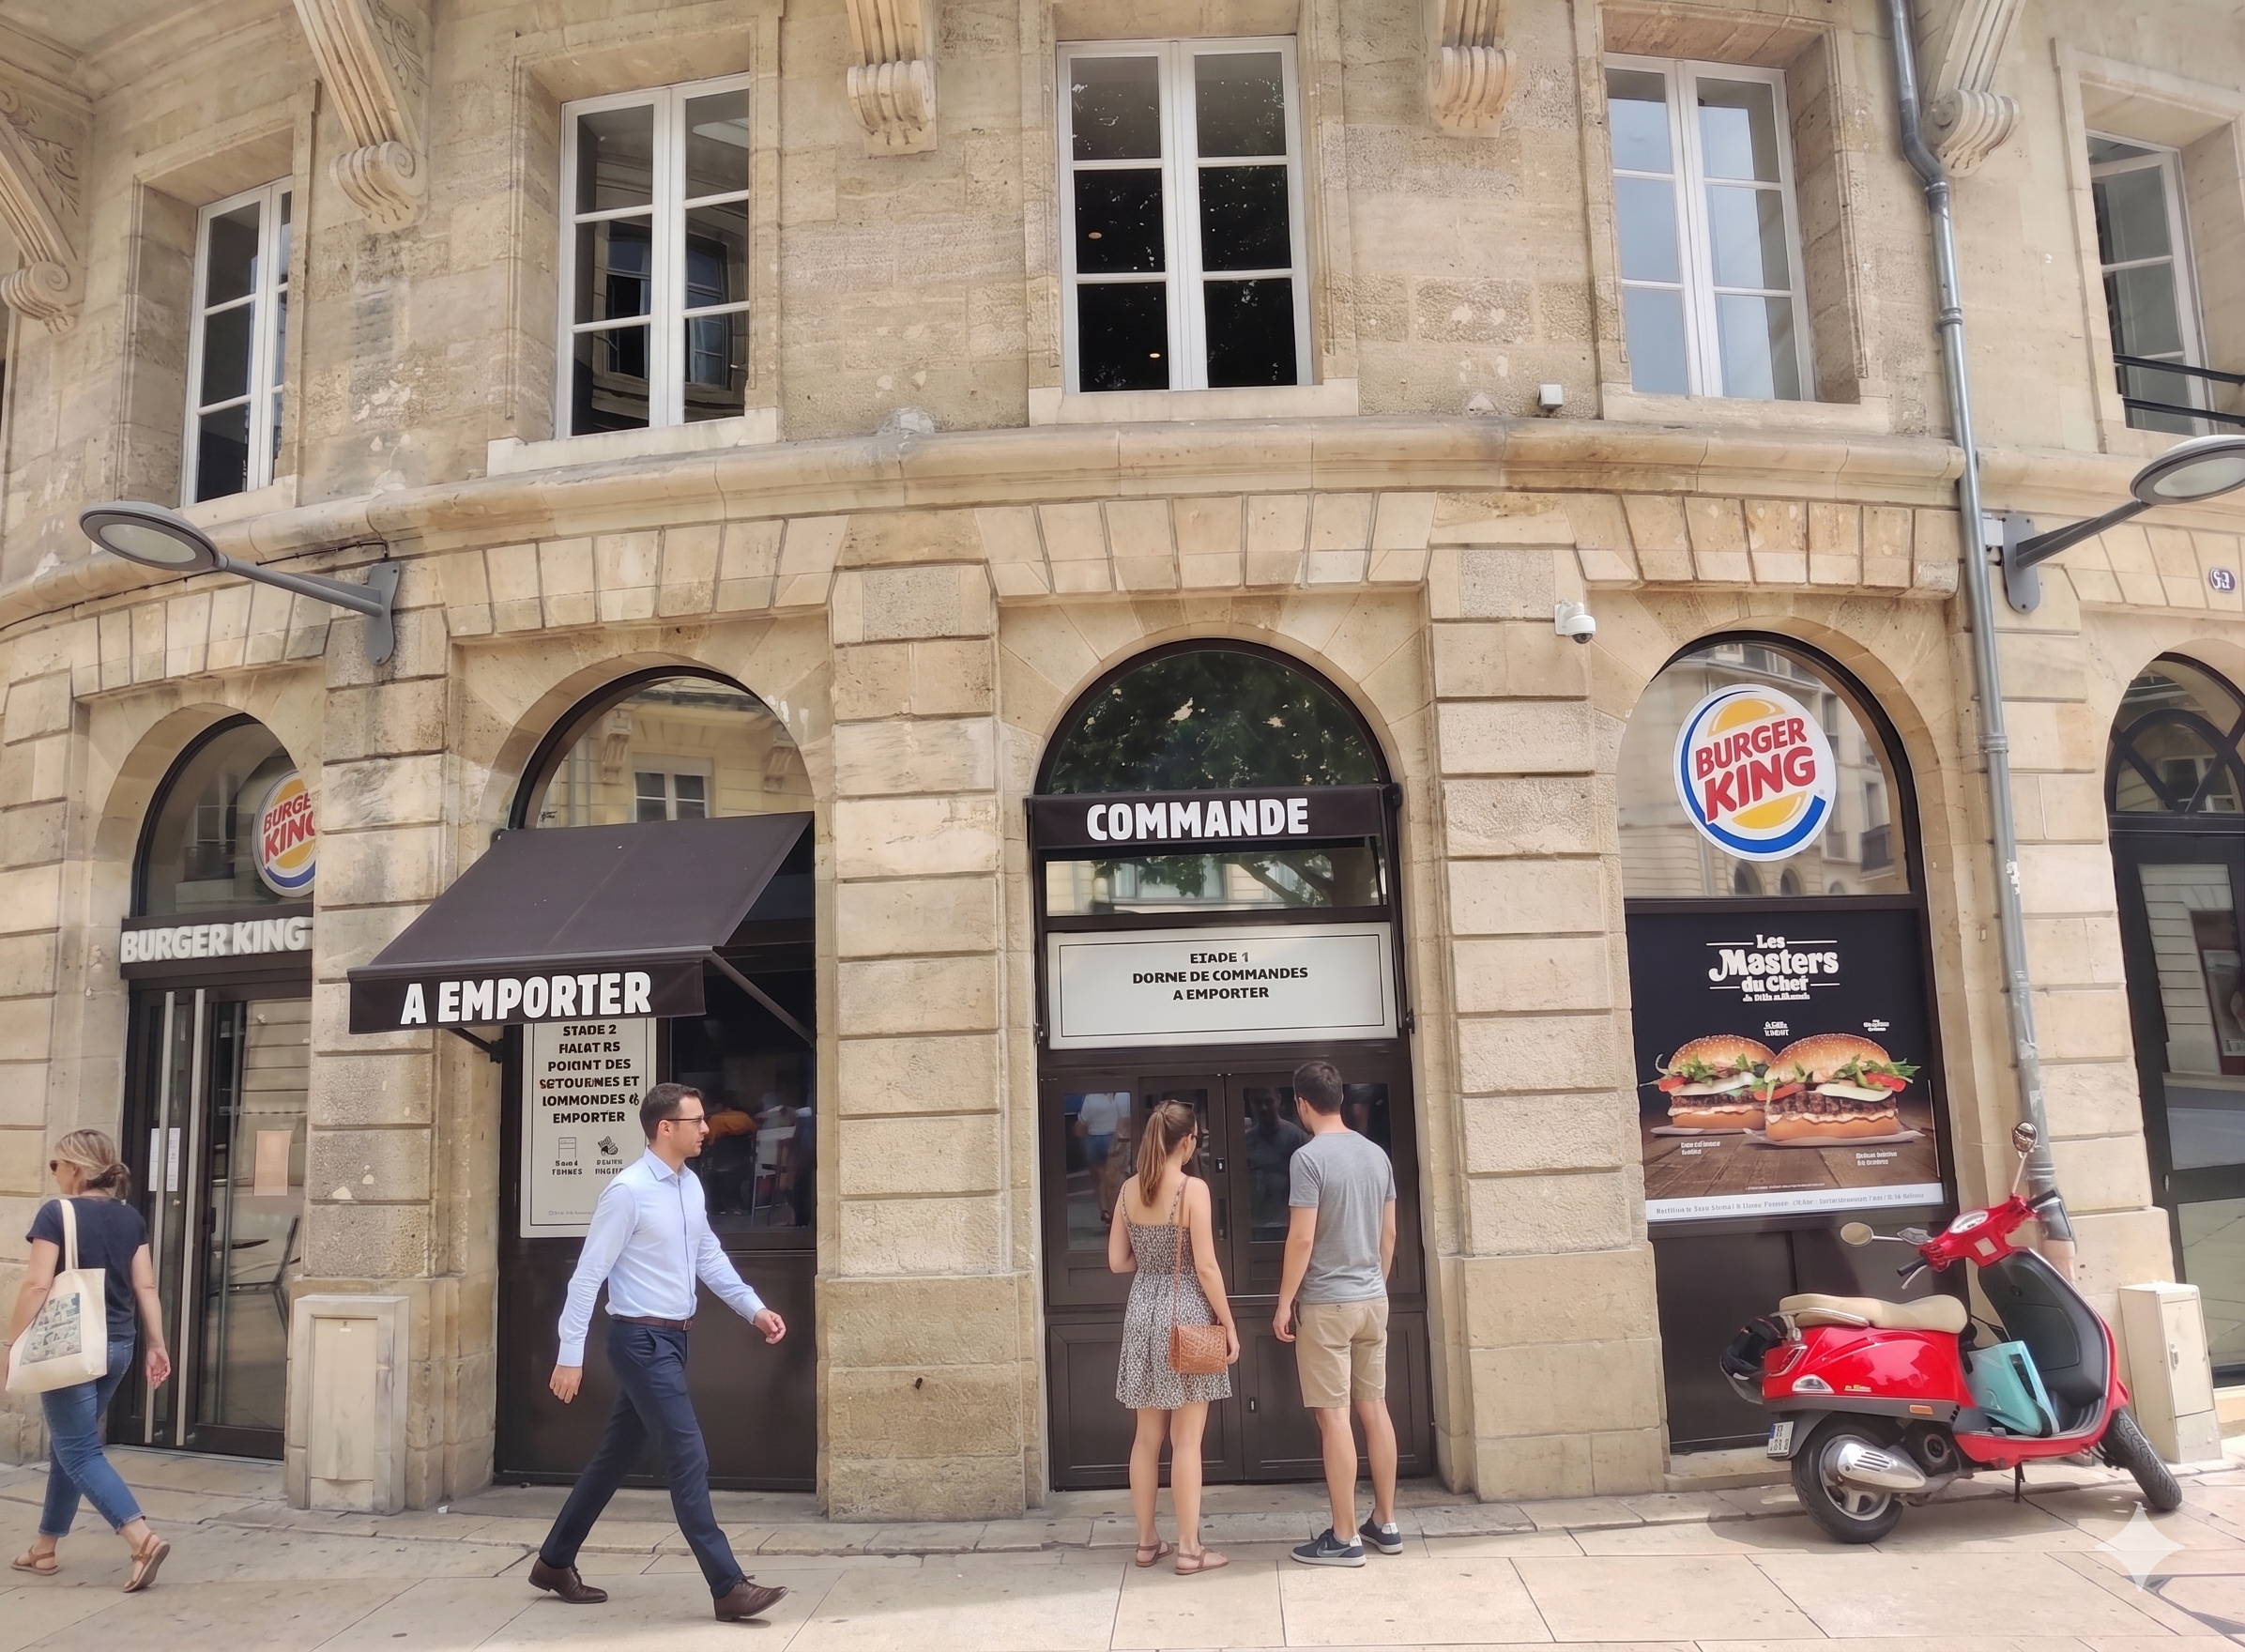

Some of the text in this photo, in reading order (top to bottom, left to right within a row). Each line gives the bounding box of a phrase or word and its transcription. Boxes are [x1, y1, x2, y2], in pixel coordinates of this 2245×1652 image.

[1695, 717, 1807, 781] BURGER
[1704, 745, 1816, 822] KING
[263, 792, 312, 834] BURGE
[1086, 797, 1309, 841] COMMANDE
[120, 916, 313, 963] BURGER KING
[1756, 934, 1785, 949] Les
[1708, 949, 1840, 982] Masters
[1190, 971, 1210, 983] DE
[1213, 967, 1309, 981] COMMANDES
[1741, 974, 1809, 993] du Chef
[400, 971, 652, 1025] A EMPORTER
[1173, 987, 1270, 1001] A EMPORTER
[563, 1024, 617, 1036] STADE 2
[603, 1041, 620, 1052] RS
[605, 1059, 631, 1070] DES
[623, 1076, 640, 1087] ET
[553, 1111, 626, 1124] EMPORTER
